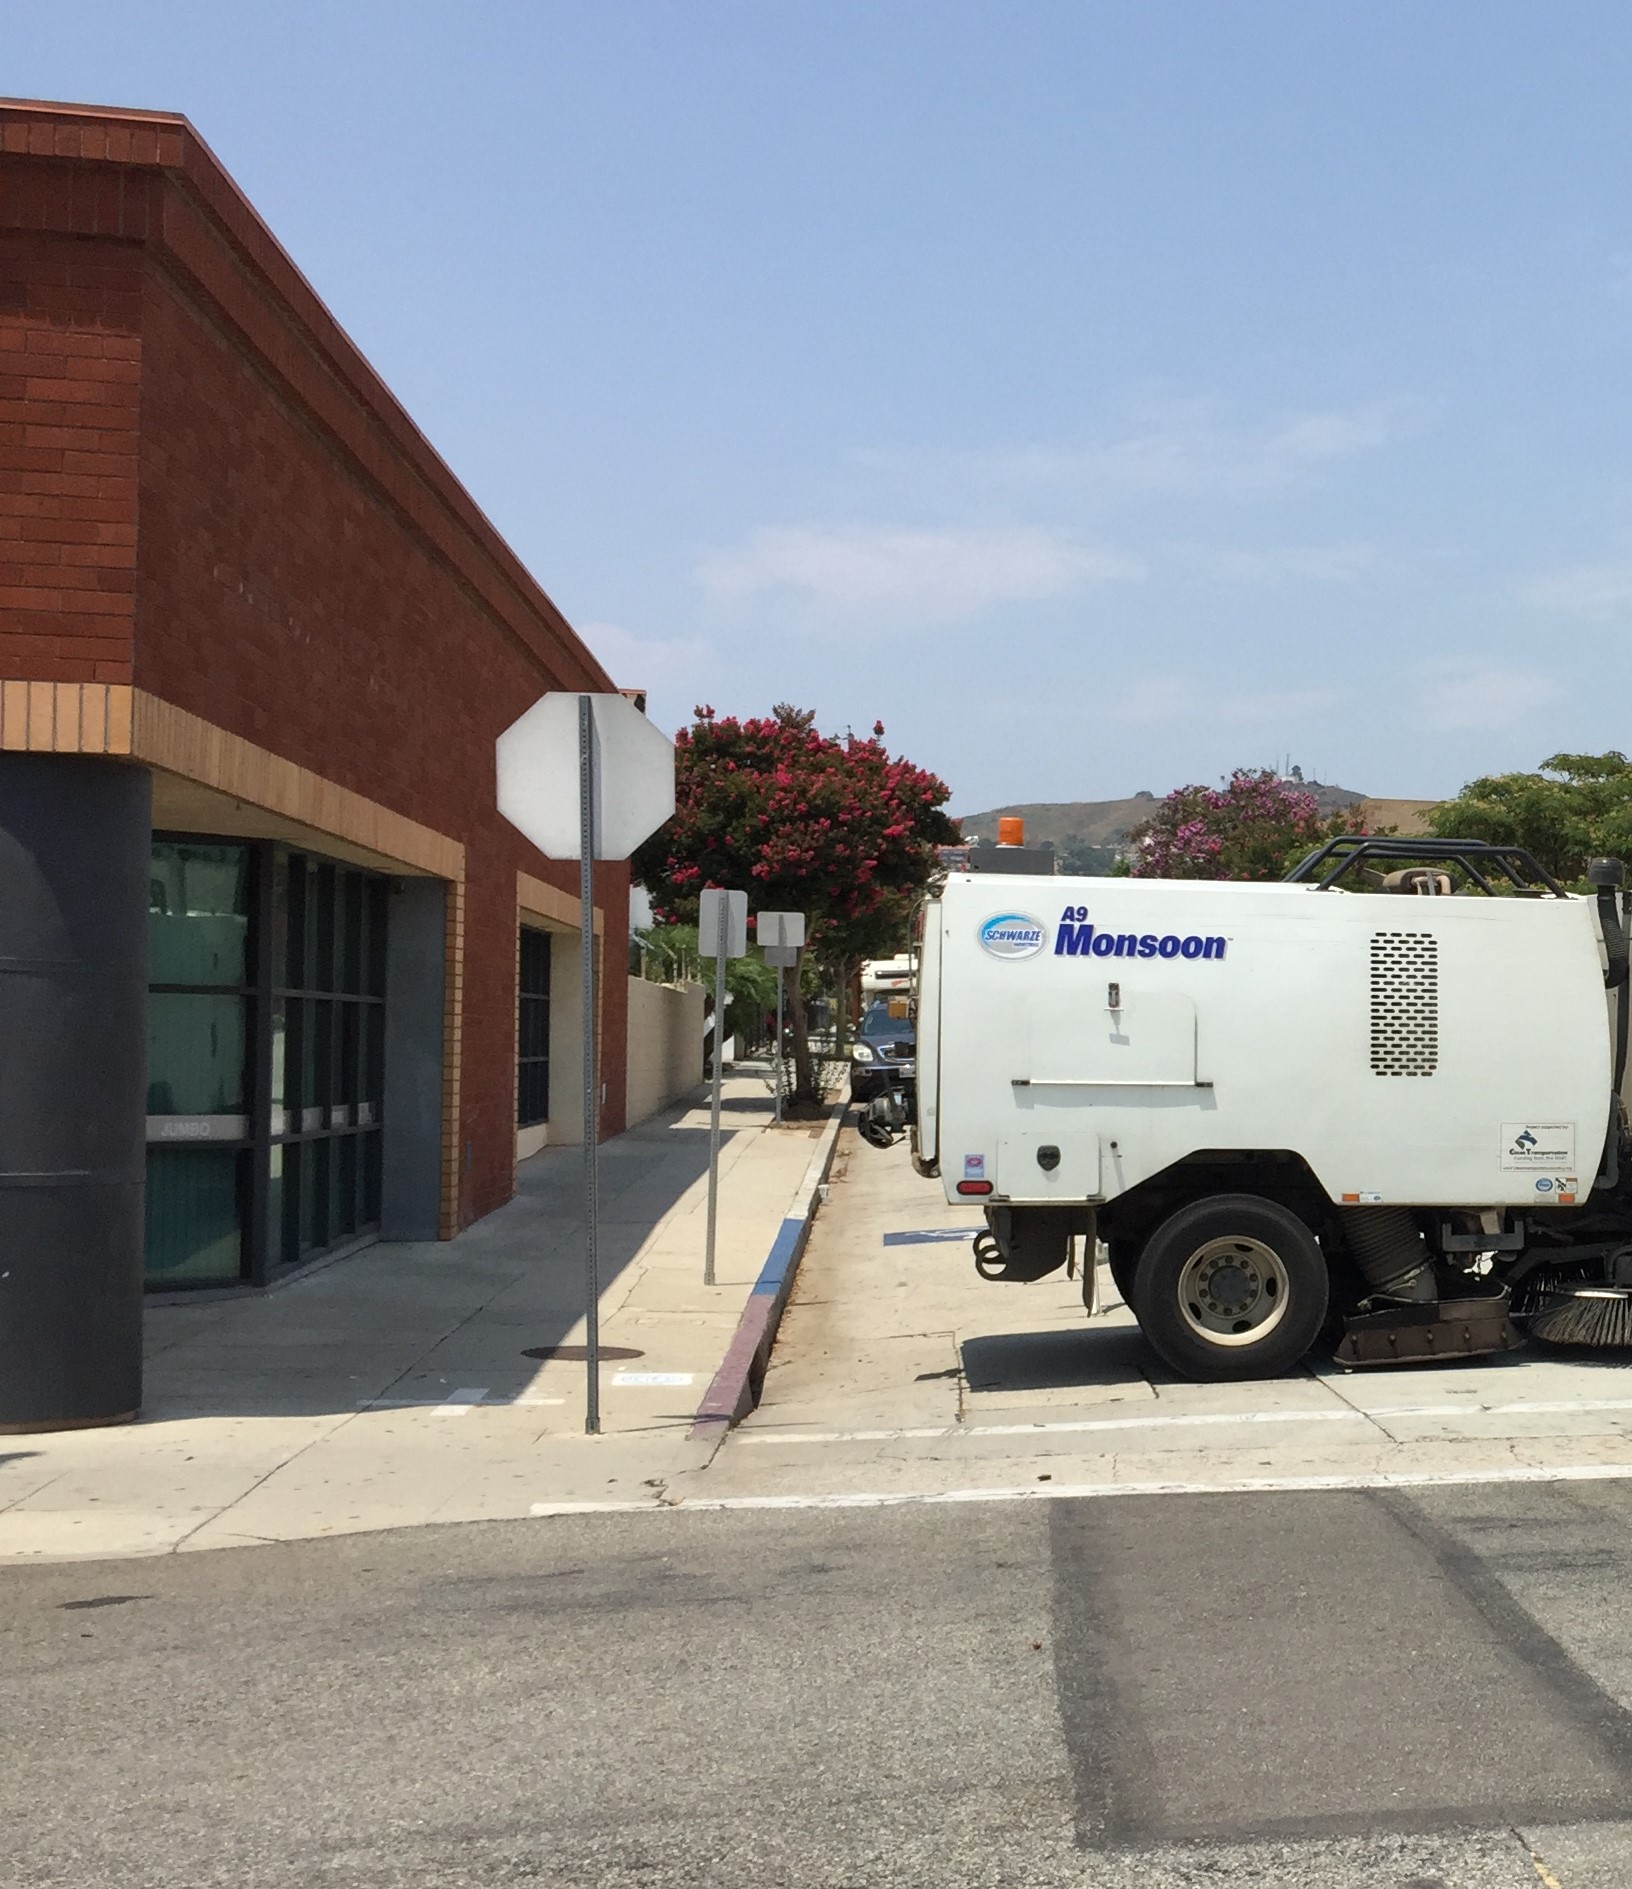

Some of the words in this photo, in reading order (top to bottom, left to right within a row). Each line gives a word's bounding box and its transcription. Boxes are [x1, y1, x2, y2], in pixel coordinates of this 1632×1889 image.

[1060, 906, 1088, 922] A9
[985, 930, 1042, 942] SCHWARZE
[1054, 924, 1227, 959] Monsoon
